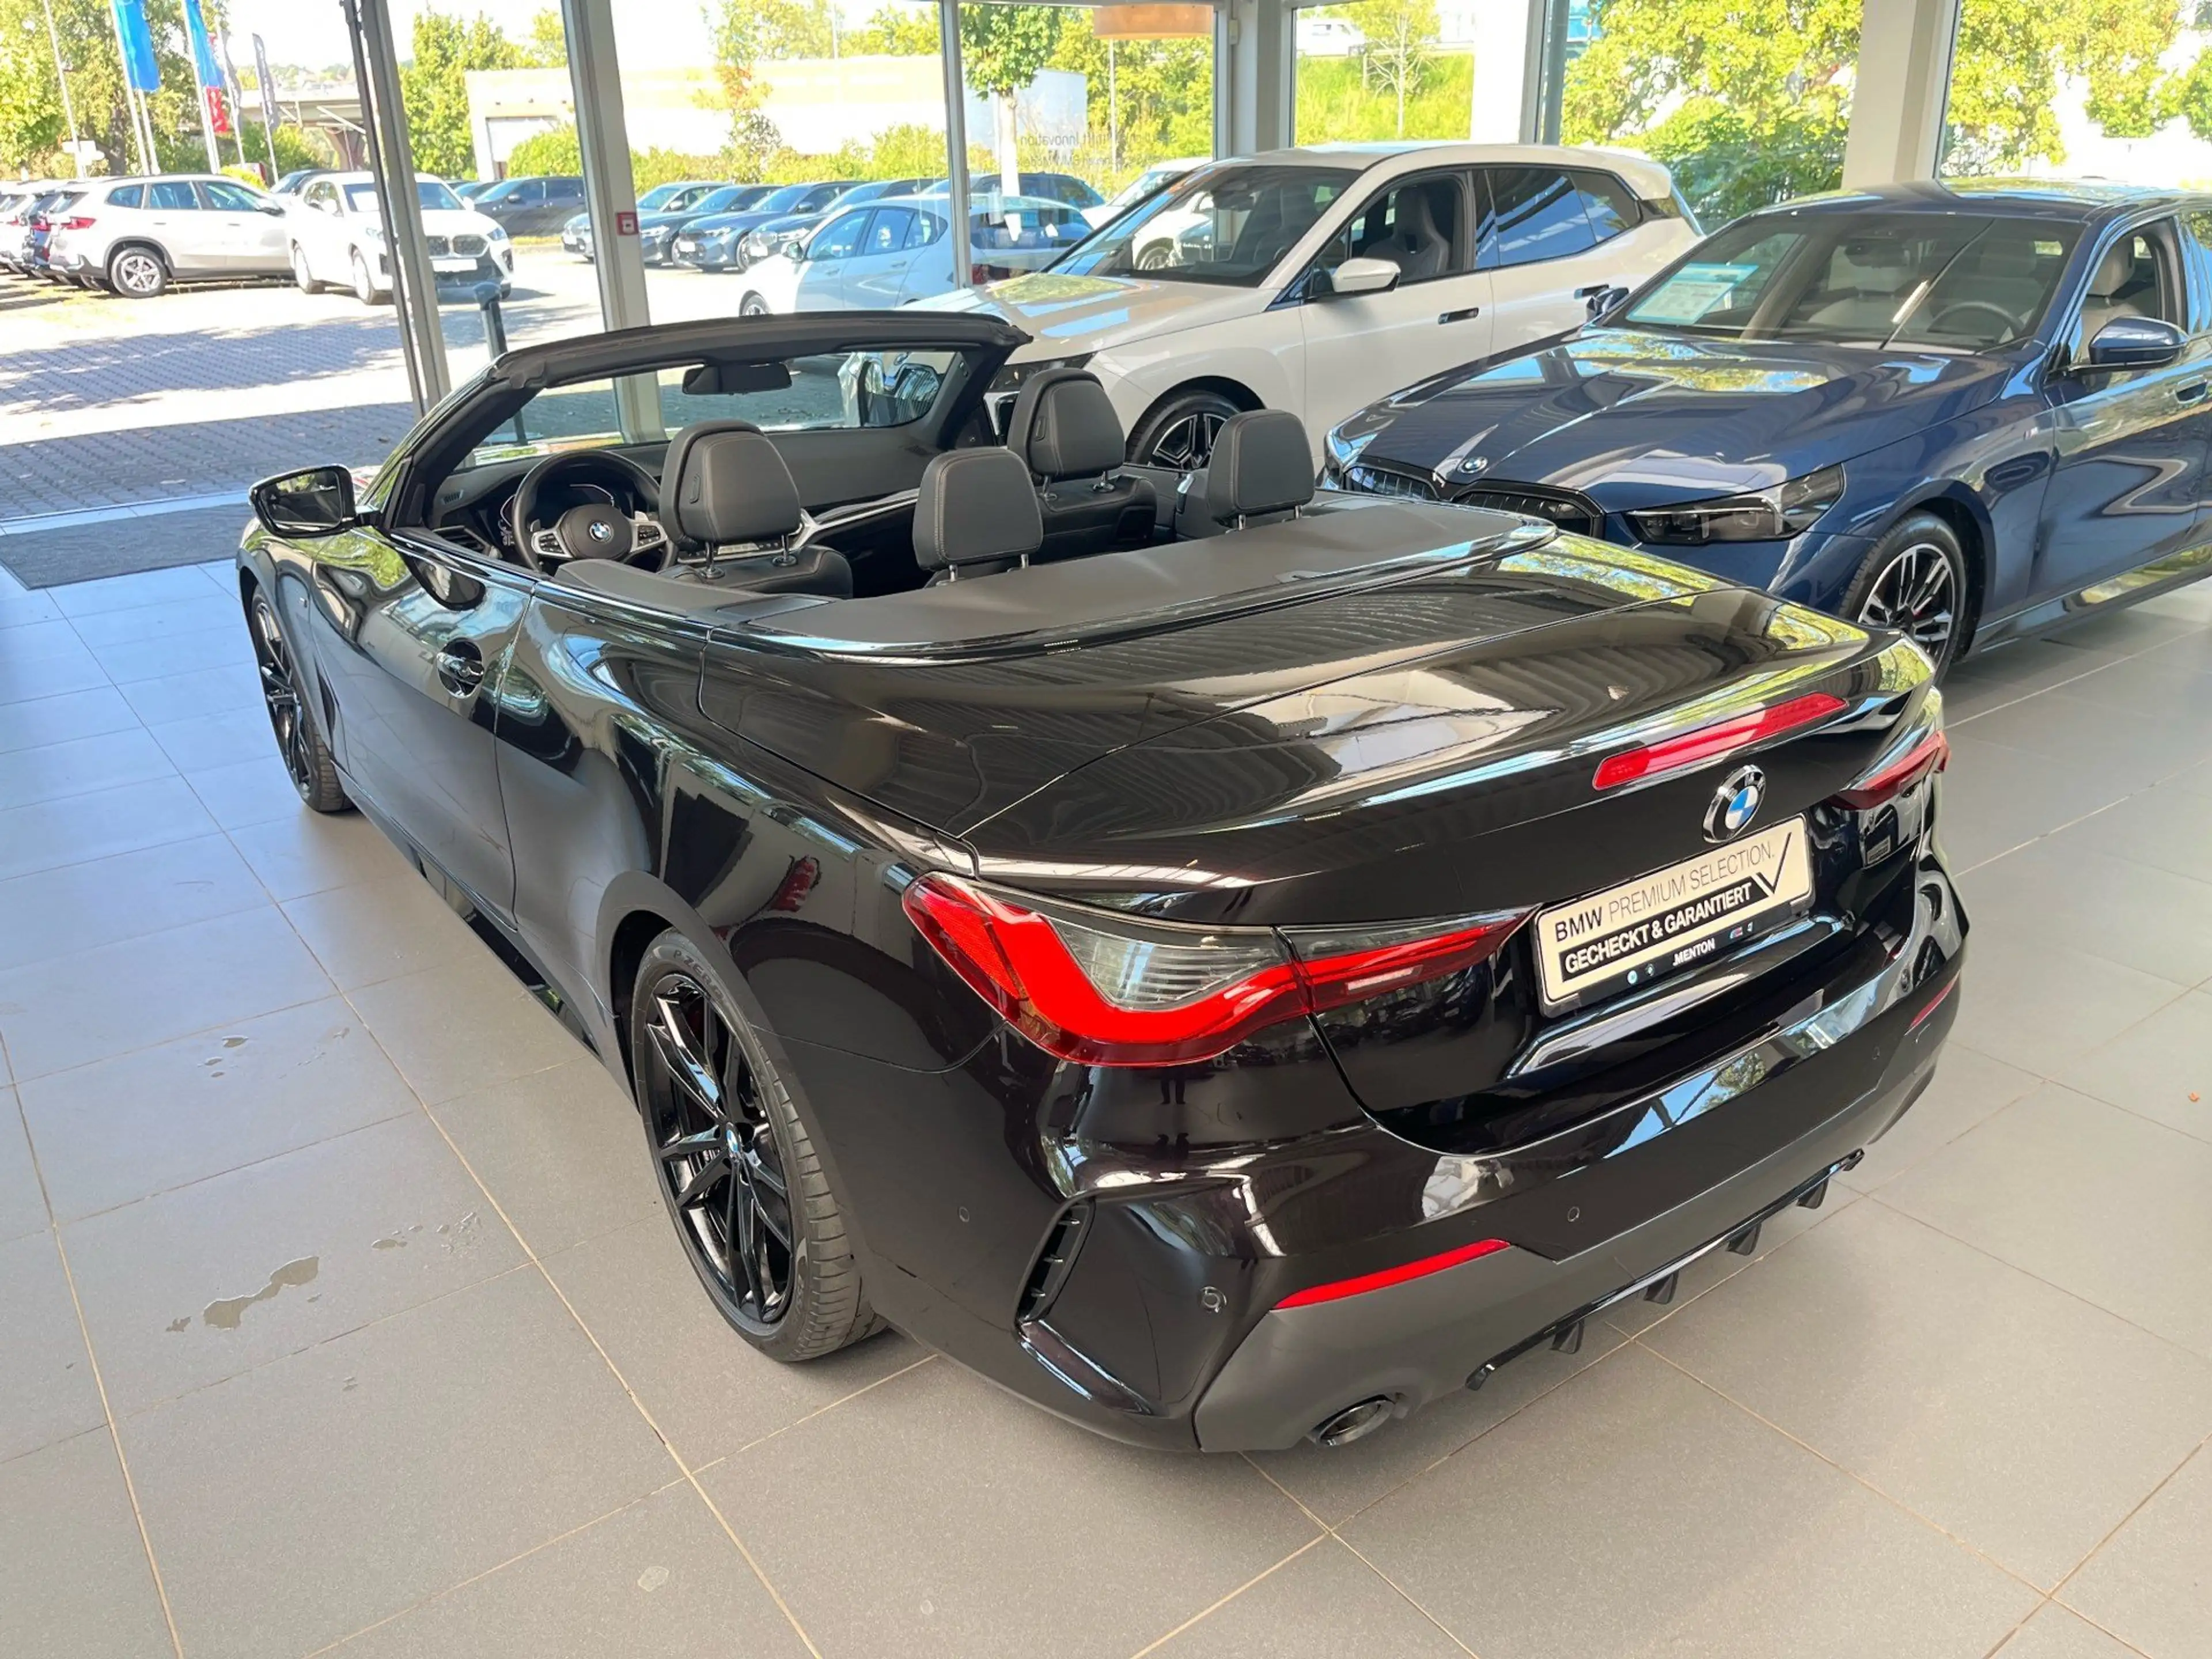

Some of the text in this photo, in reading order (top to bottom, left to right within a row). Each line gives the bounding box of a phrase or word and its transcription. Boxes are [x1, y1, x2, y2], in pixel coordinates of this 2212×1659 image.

[1555, 907, 1603, 942] BMW
[1609, 874, 1687, 922] PREMIUM
[1565, 882, 1752, 974] GECHECKT & GARANTIERT
[1672, 937, 1715, 967] MENTON
